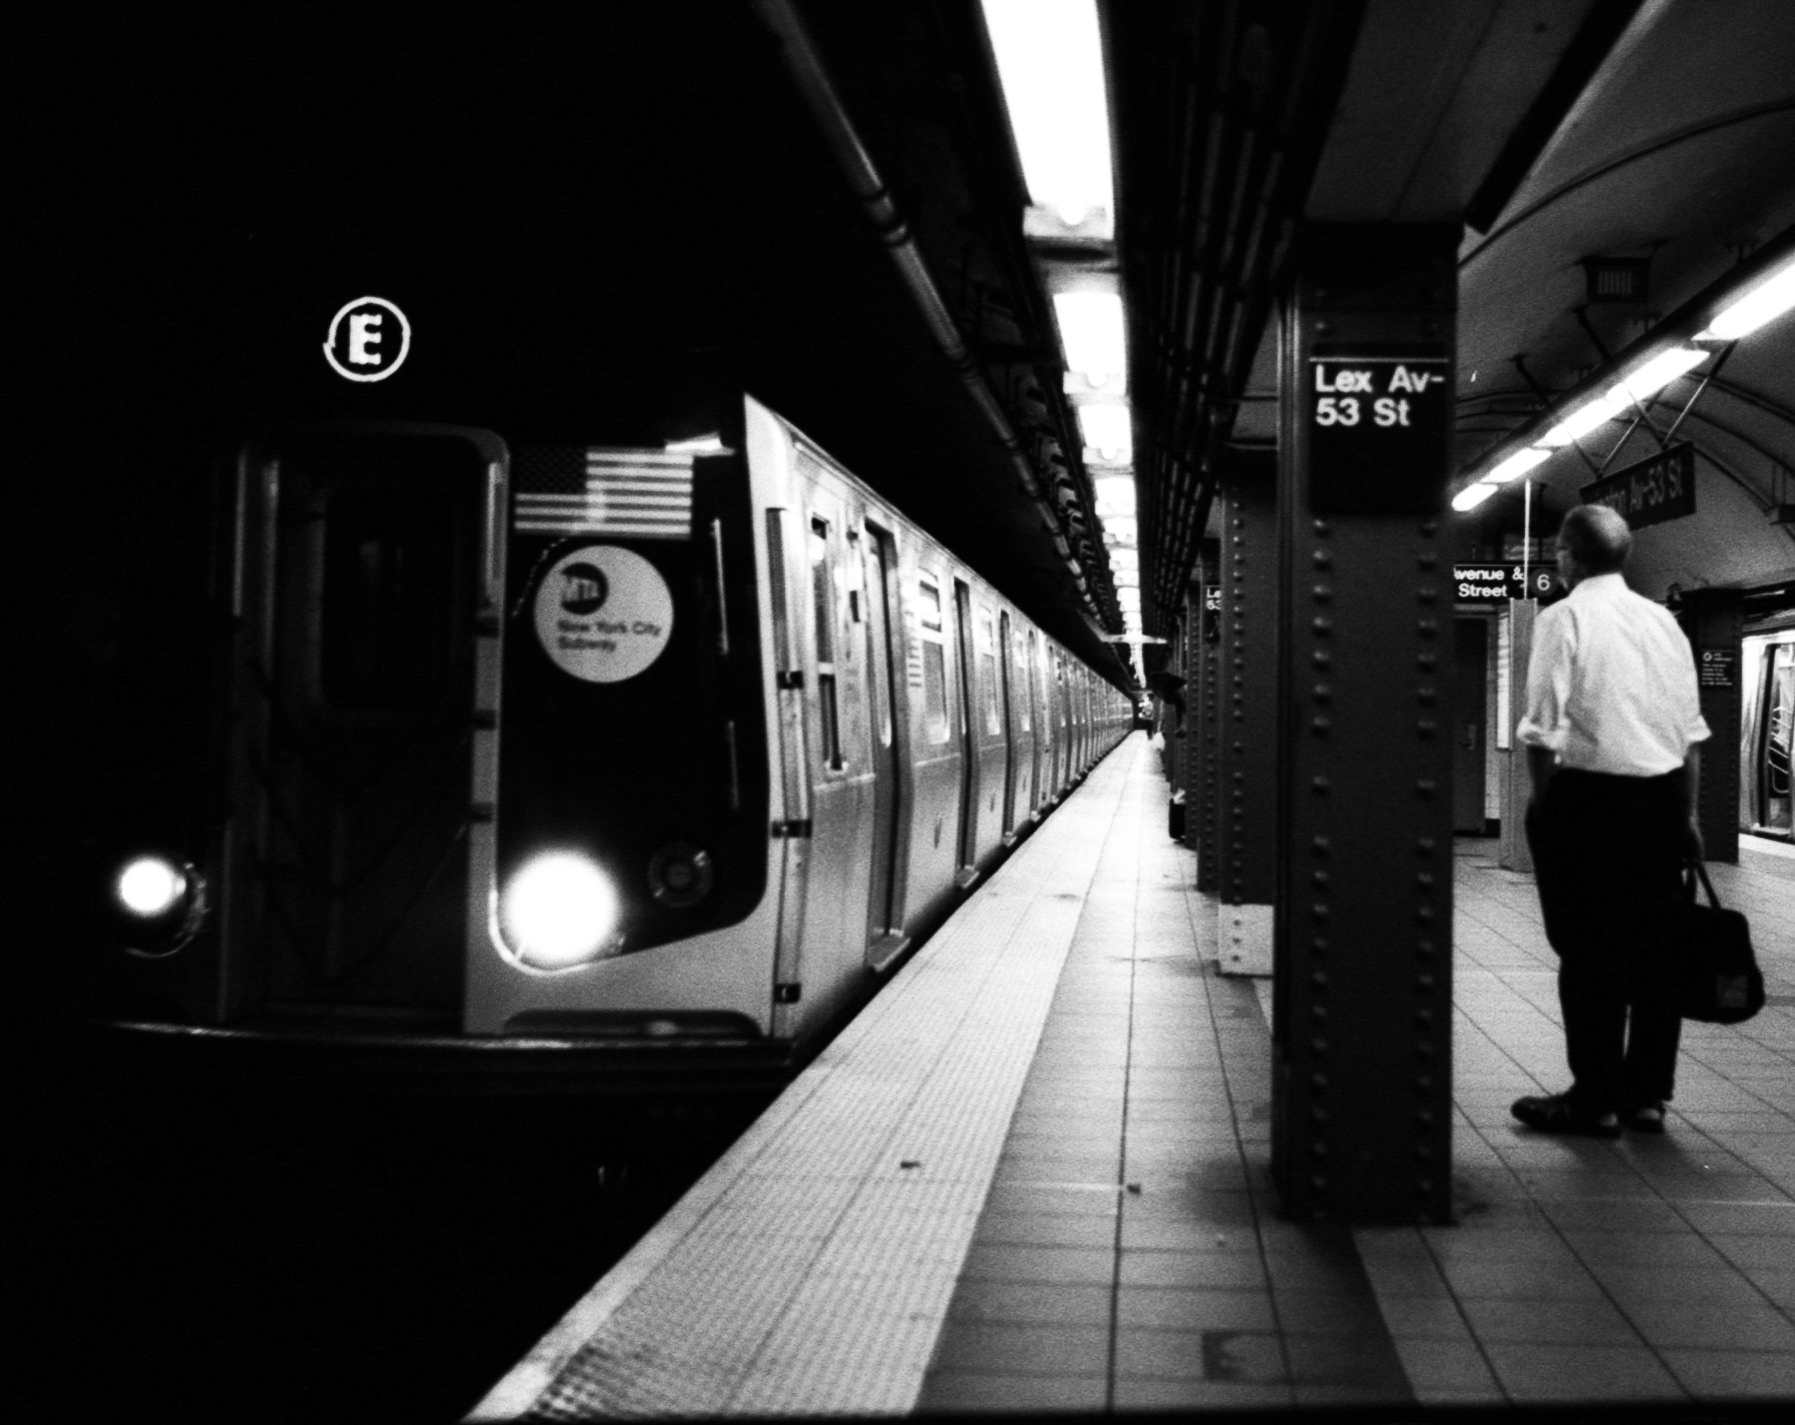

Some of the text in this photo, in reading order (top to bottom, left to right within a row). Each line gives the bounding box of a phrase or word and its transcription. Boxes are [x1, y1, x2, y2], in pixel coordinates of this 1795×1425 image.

[348, 313, 383, 365] E
[1315, 364, 1446, 393] Lex Av-
[1315, 397, 1411, 427] 53 St
[1457, 582, 1508, 598] Street
[1536, 573, 1551, 592] 6
[1206, 586, 1222, 599] Le
[557, 619, 662, 637] New York City
[557, 636, 617, 653] Subway
